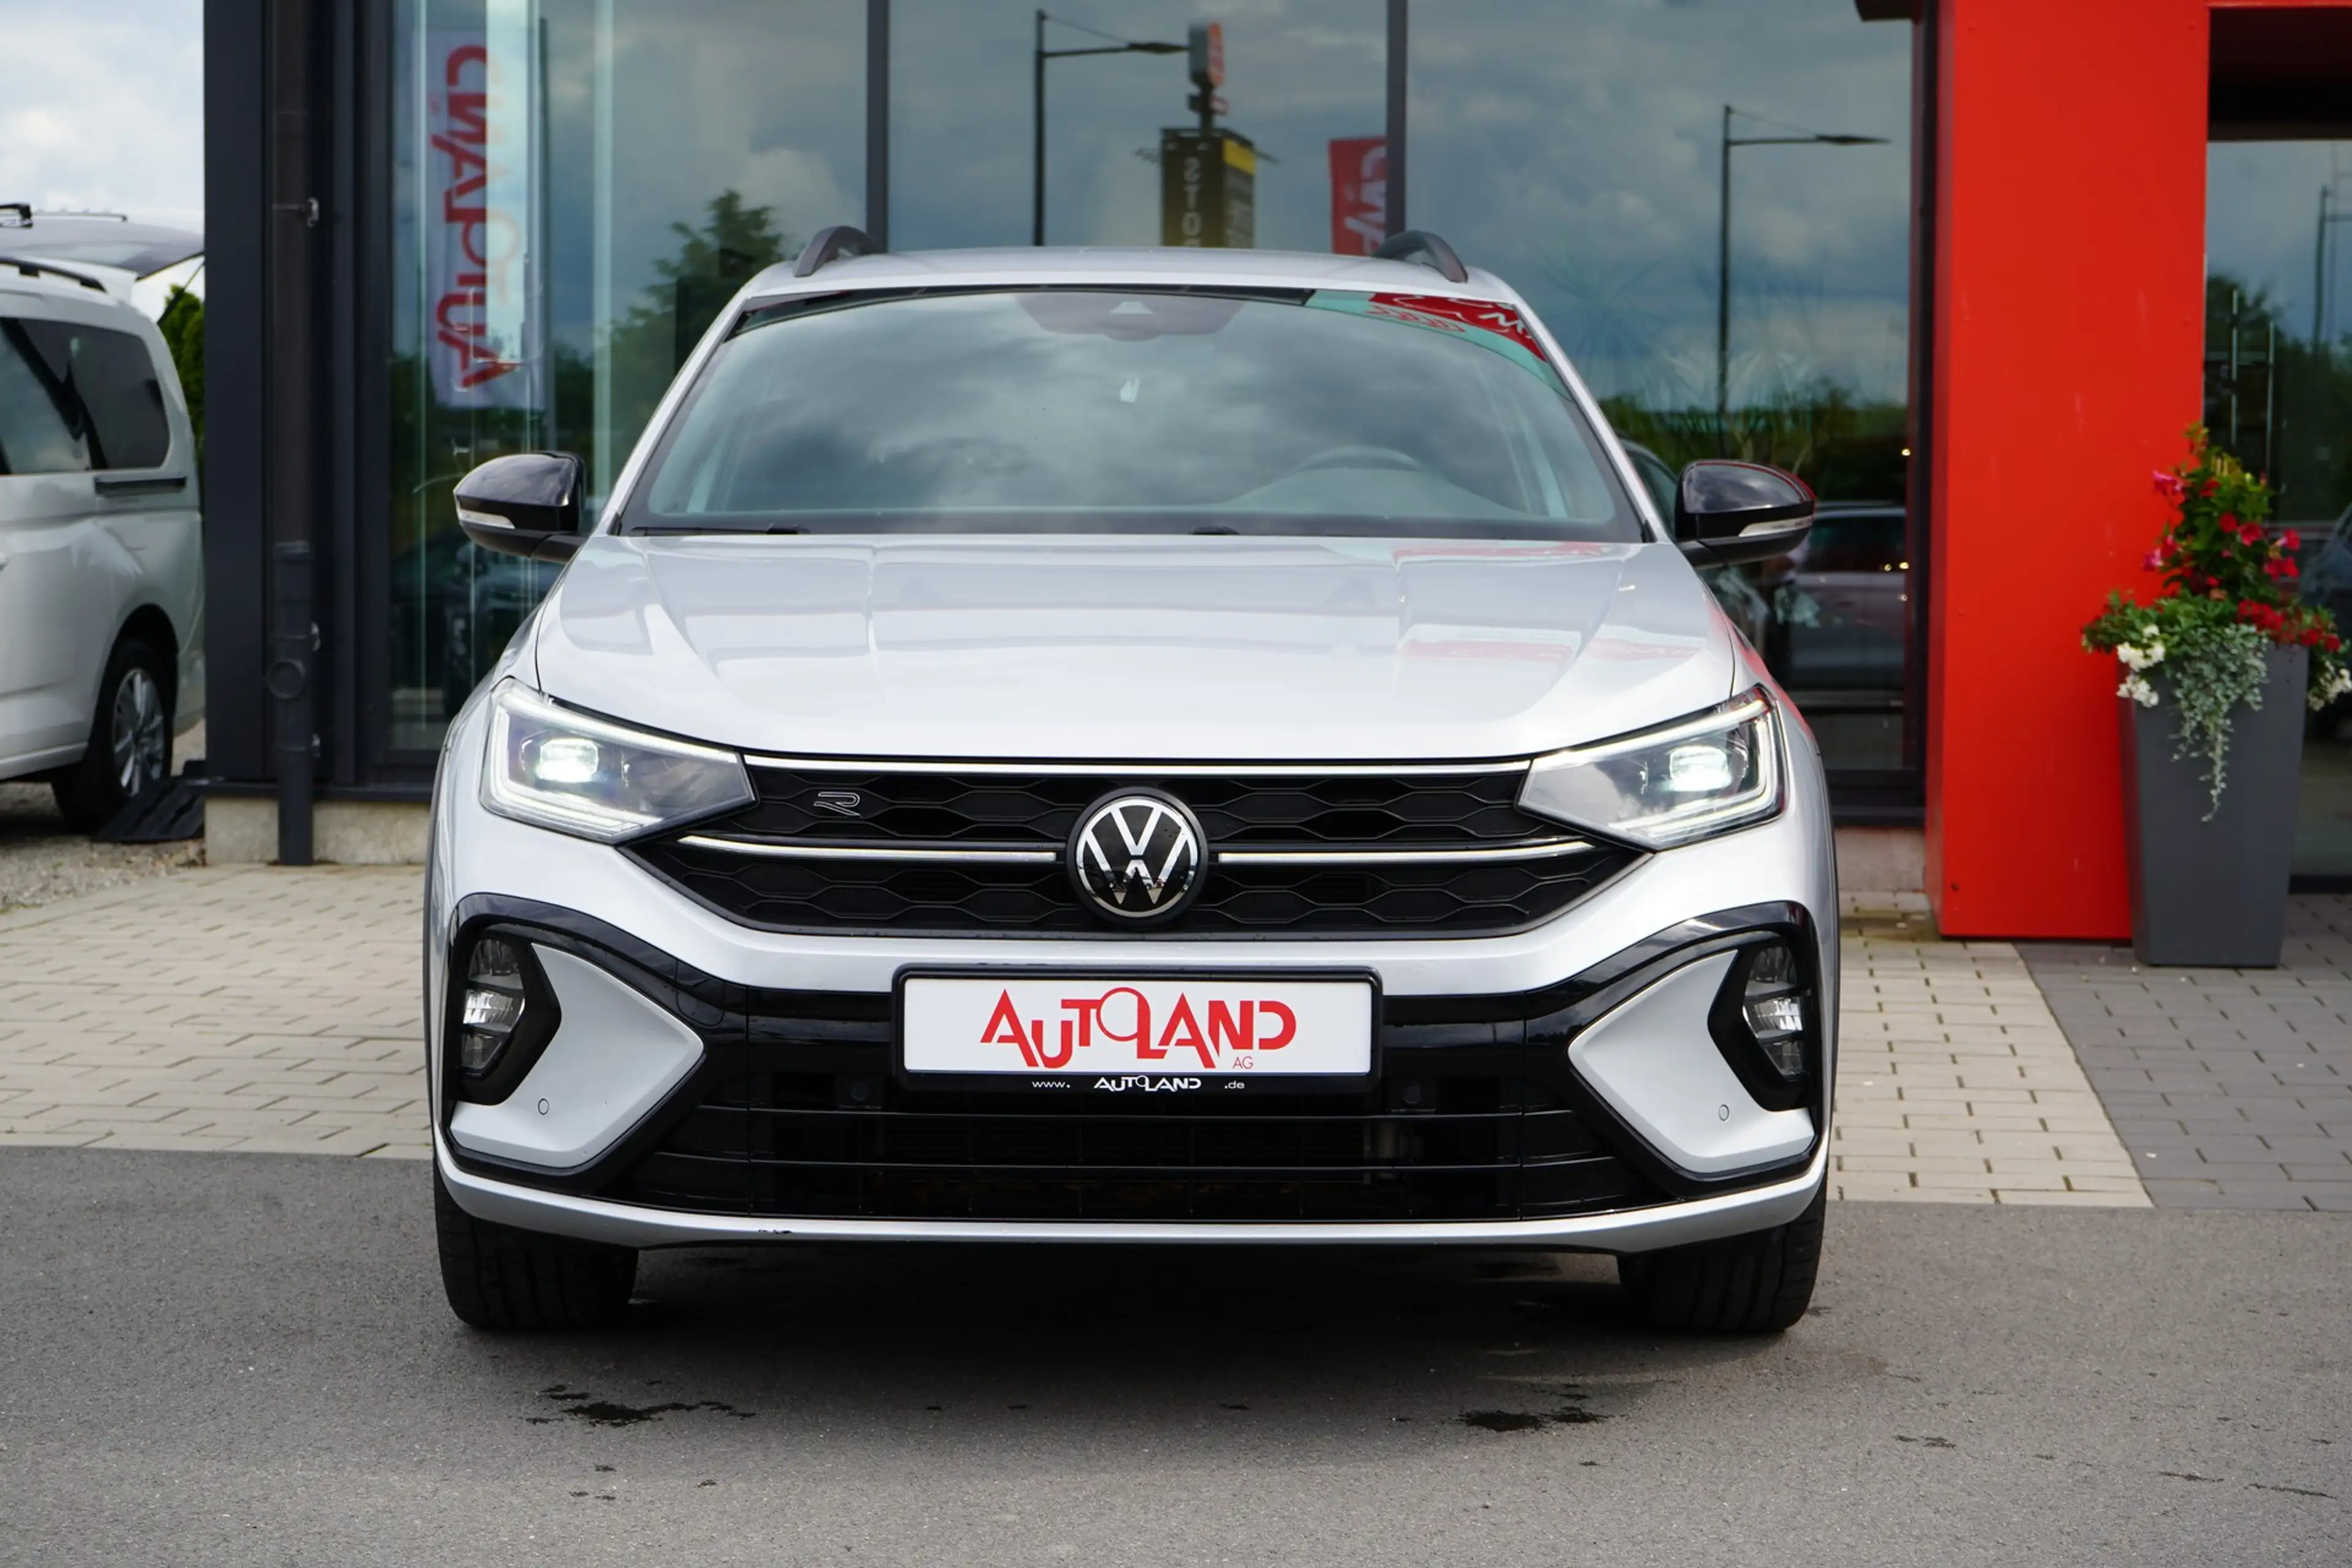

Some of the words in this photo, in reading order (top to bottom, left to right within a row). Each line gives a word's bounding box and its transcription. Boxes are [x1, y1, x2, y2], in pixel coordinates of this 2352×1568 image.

[980, 987, 1297, 1069] AUTOLAND
[1232, 1057, 1253, 1069] AG
[1094, 1075, 1202, 1093] AUTOLAND
[1224, 1080, 1245, 1089] .de
